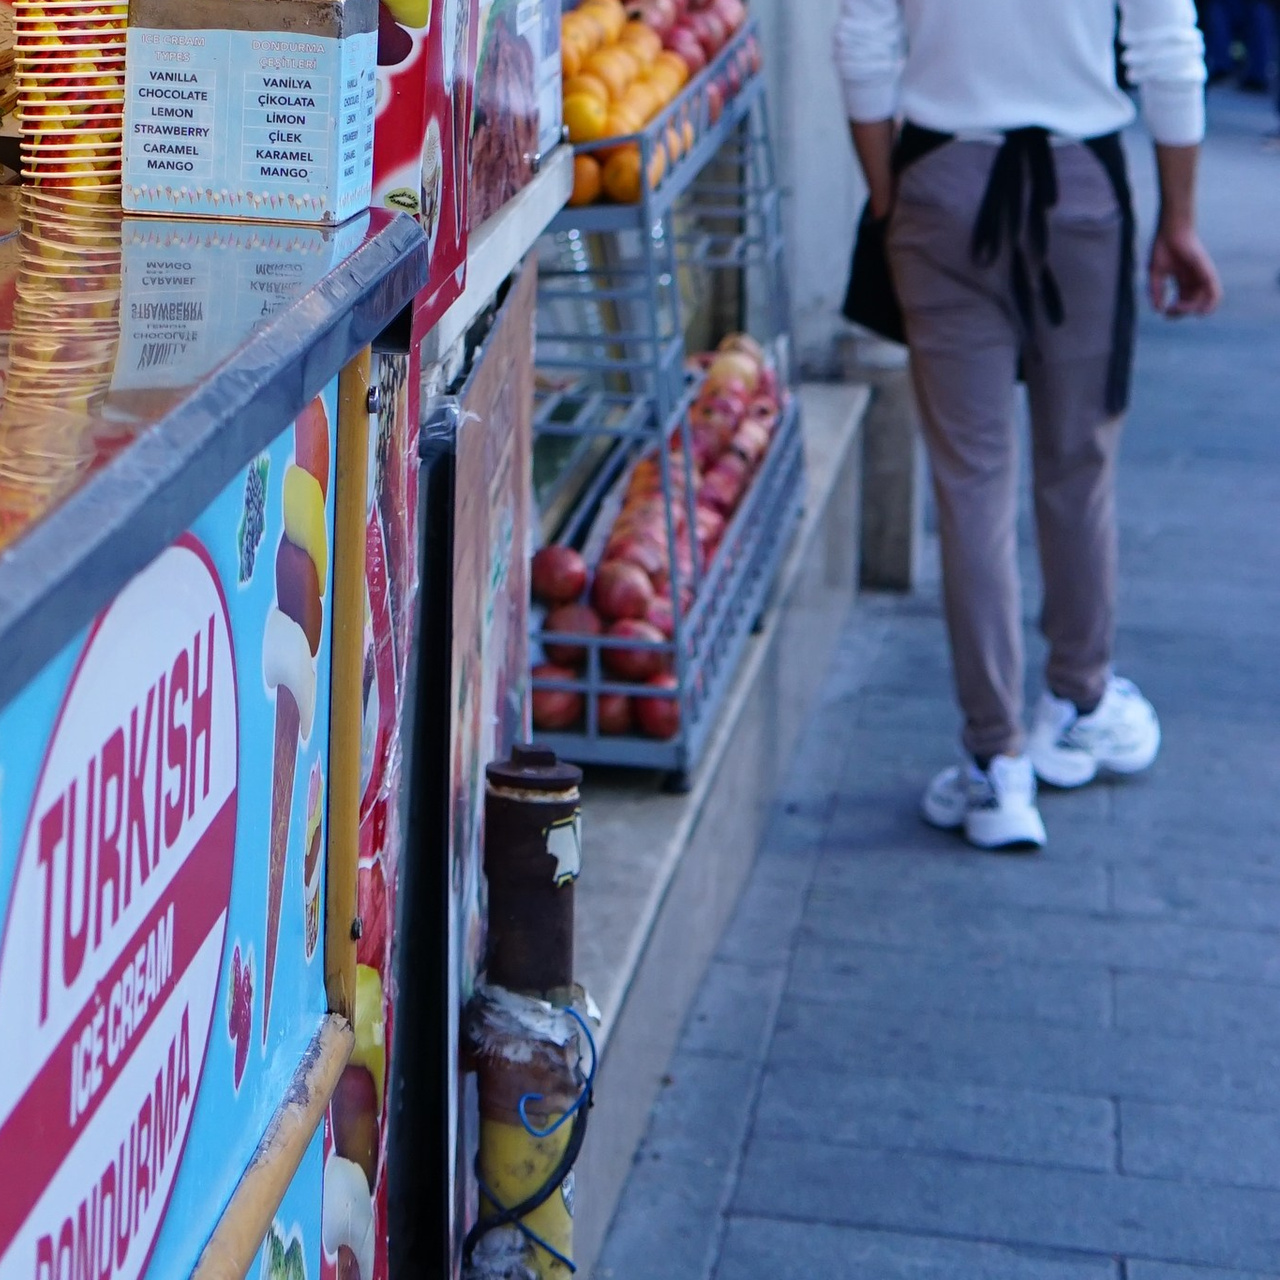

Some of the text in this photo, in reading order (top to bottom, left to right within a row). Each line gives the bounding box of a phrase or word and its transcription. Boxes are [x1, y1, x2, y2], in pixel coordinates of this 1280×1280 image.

[141, 34, 205, 47] ICE CREAM
[252, 40, 325, 54] DONDURMA
[155, 51, 190, 63] TYPES
[149, 70, 198, 84] VANILLA
[263, 75, 312, 90] VANİLYA
[138, 87, 208, 101] CHOCOLATE
[257, 93, 315, 108] ÇİKOLATA
[151, 107, 194, 119] LEMON
[266, 111, 306, 125] LİMON
[134, 124, 210, 138] STRAWBERRY
[268, 131, 302, 144] ÇİLEK
[143, 143, 199, 156] CARAMEL
[256, 149, 313, 162] KARAMEL
[147, 160, 193, 171] MANGO
[260, 166, 308, 178] MANGO
[37, 611, 215, 1029] TURKISH
[69, 901, 175, 1128] ICE CREAM
